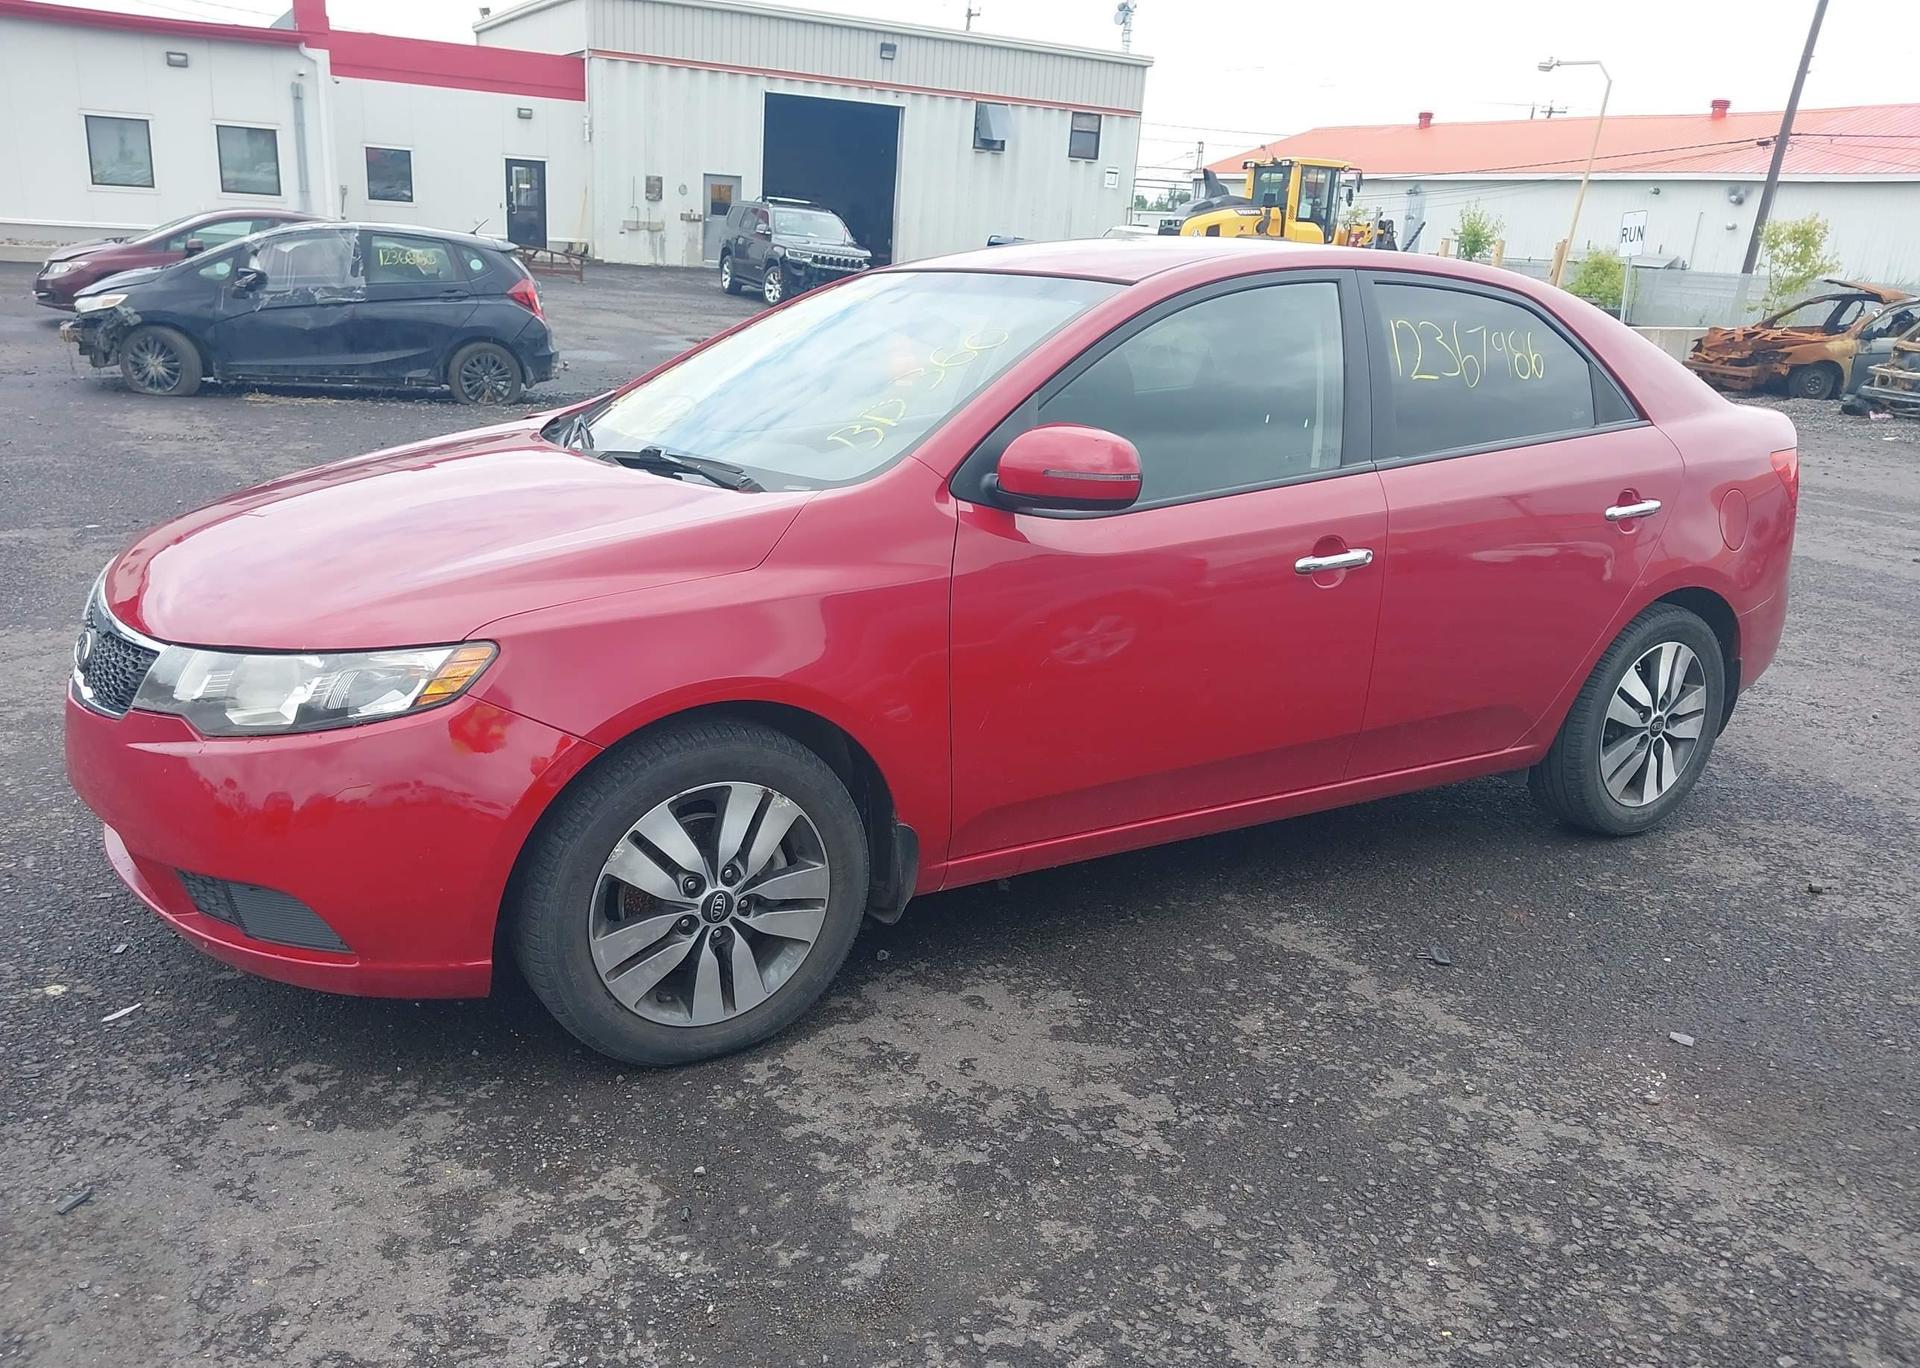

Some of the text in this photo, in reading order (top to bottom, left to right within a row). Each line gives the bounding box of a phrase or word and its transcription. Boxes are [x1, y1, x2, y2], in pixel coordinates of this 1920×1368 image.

[1620, 225, 1645, 243] RUN
[1389, 319, 1545, 388] 12367986
[712, 898, 724, 918] KIA
